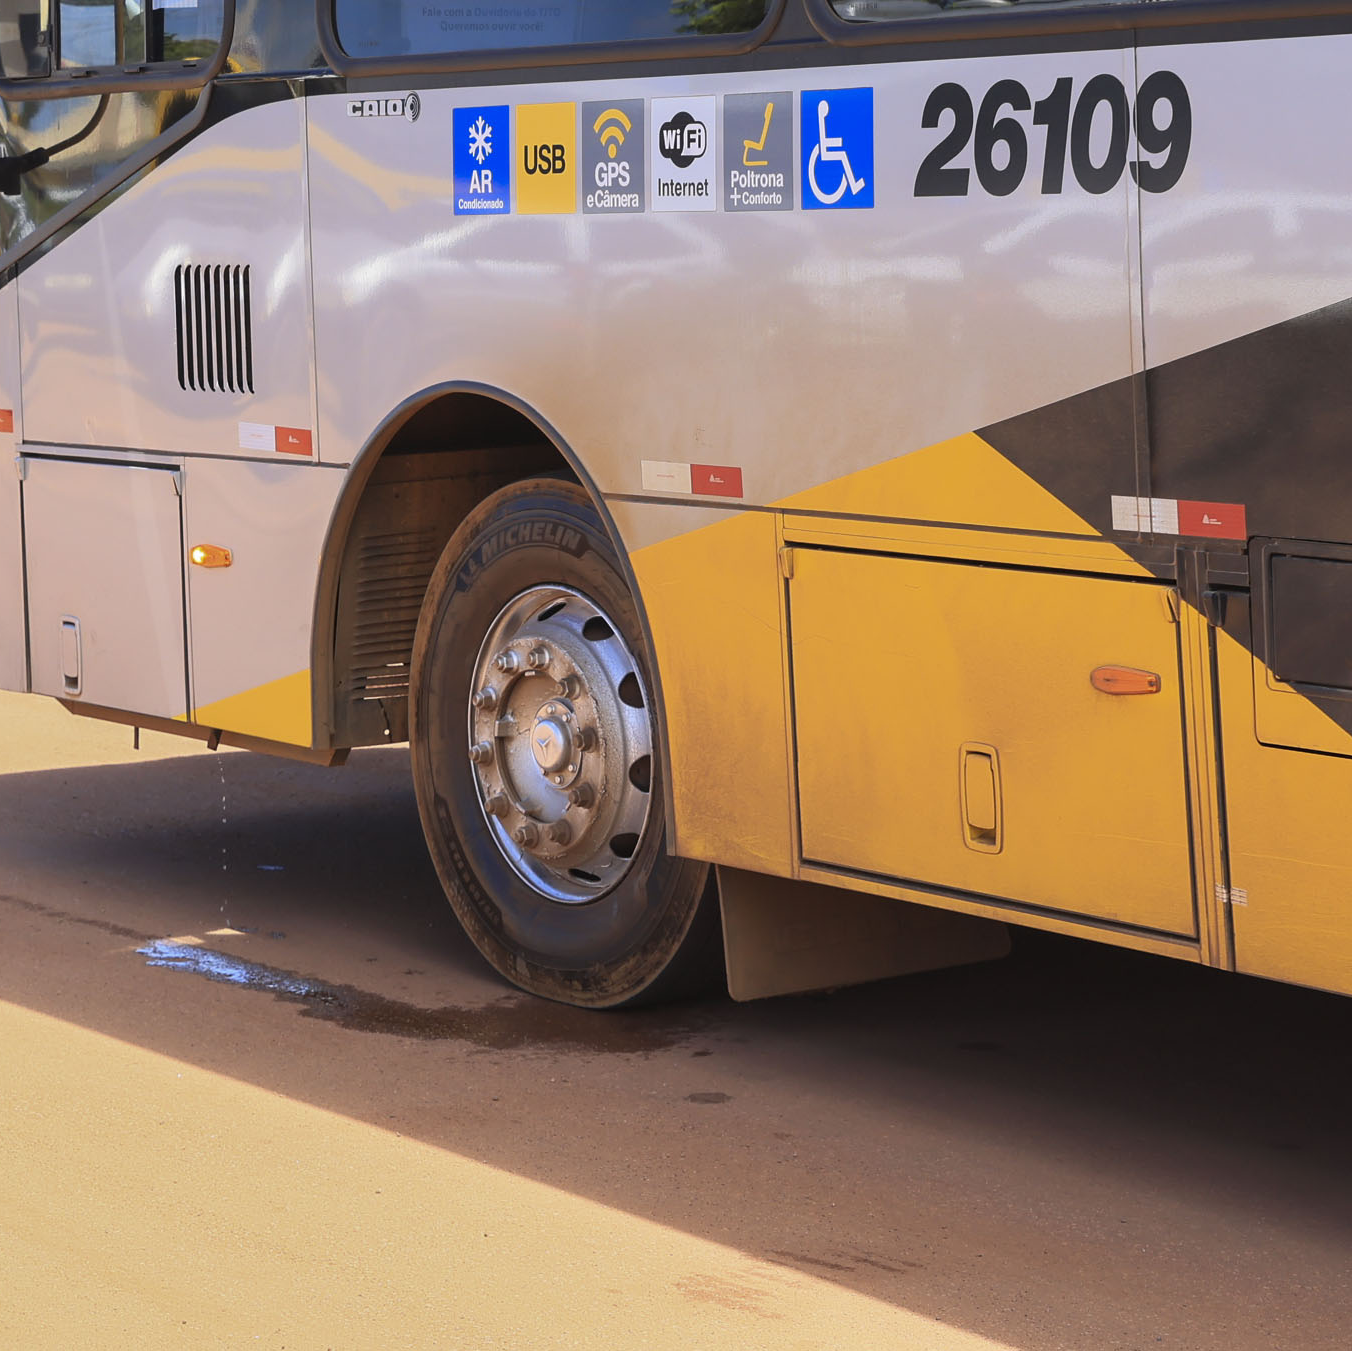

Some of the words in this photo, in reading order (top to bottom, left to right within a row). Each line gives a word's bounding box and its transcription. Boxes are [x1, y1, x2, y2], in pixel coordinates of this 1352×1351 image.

[346, 98, 405, 117] CAIO
[913, 70, 1192, 197] 26109
[523, 143, 566, 175] USB
[469, 169, 493, 194] AR
[594, 161, 630, 187] GPS
[731, 169, 784, 188] Poltrona
[658, 178, 709, 197] Internet
[458, 198, 504, 210] Condicionado
[594, 190, 639, 208] Câmera
[481, 521, 582, 564] MICHELIN
